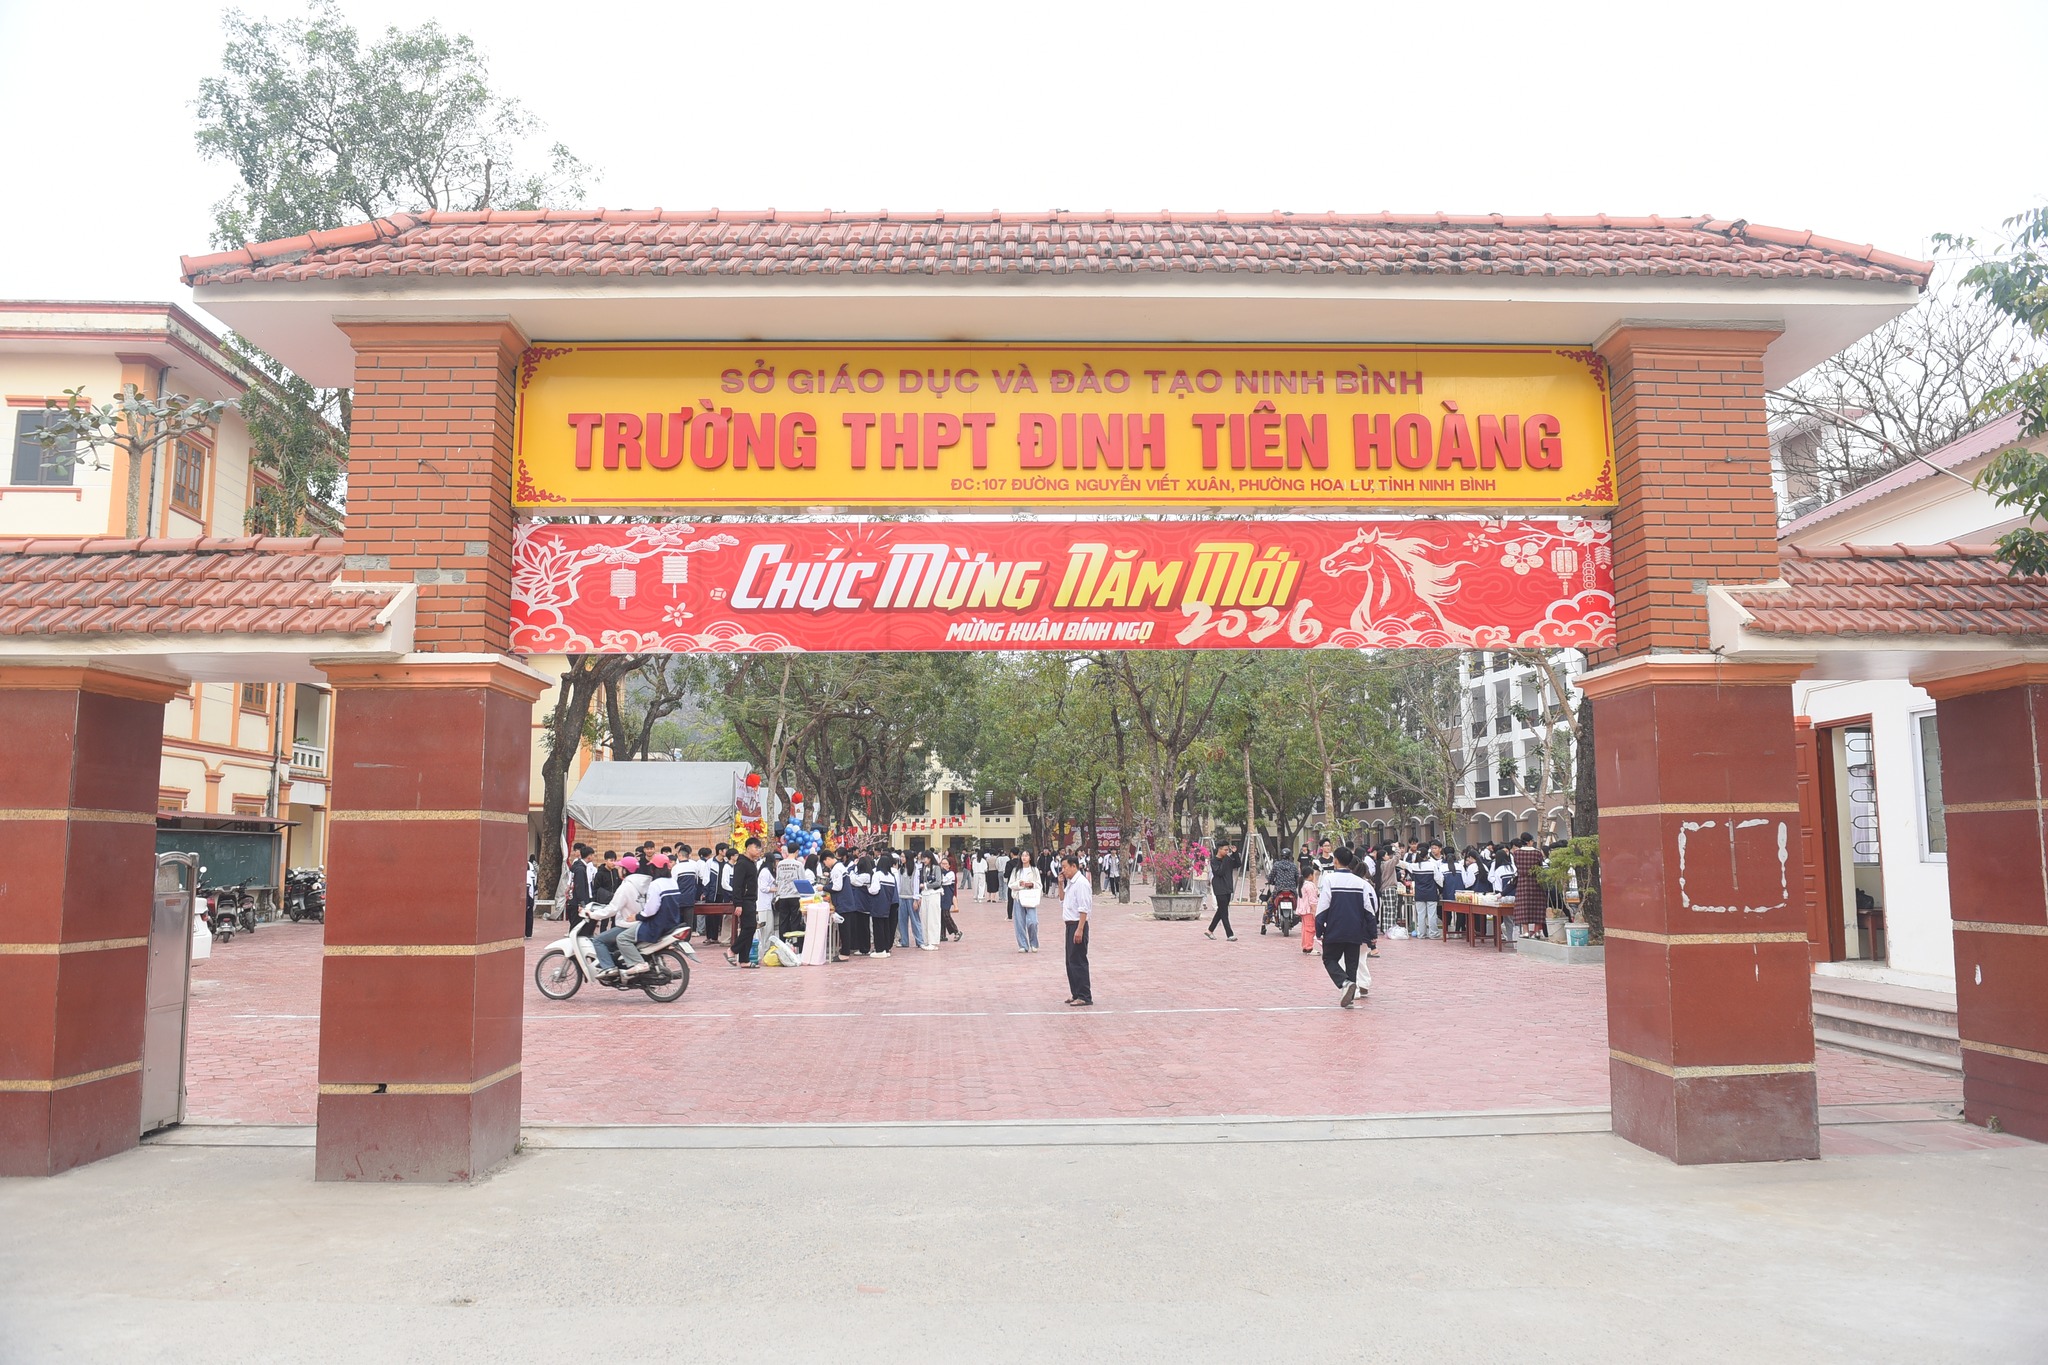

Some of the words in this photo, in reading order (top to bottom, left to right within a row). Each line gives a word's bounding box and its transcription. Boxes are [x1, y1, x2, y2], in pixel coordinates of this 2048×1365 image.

[720, 359, 775, 394] SỞ
[787, 362, 885, 394] GIÁO
[899, 368, 979, 398] DỤC
[991, 362, 1038, 394] VÀ
[1051, 362, 1131, 394] ĐÀO
[1143, 369, 1223, 399] TẠO
[1235, 369, 1324, 395] NINH
[1336, 364, 1424, 395] BÌNH
[568, 398, 818, 471] TRƯỜNG
[842, 412, 996, 471] THPT
[1017, 412, 1167, 471] ĐINH
[1192, 400, 1329, 471] TIÊN
[1352, 400, 1563, 472] HOÀNG
[1011, 475, 1069, 491] ĐƯỜNG
[1076, 474, 1141, 491] NGUYỄN
[1146, 473, 1180, 491] VIẾT
[1186, 476, 1235, 493] XUÂN,
[1239, 476, 1305, 491] PHƯỜNG
[1310, 479, 1344, 491] HOA
[1378, 476, 1415, 491] TỈNH
[1419, 479, 1455, 491] NINH
[1460, 476, 1496, 491] BÌNH
[730, 543, 878, 612] CHÚC
[873, 543, 1043, 611] MỪNG
[1053, 543, 1183, 607] NĂM
[1183, 542, 1300, 607] MỚI
[946, 617, 1006, 643] MỪNG
[1006, 617, 1064, 643] XUÂN
[1064, 617, 1116, 641] BÍNH
[1112, 621, 1155, 644] NGỌ
[1175, 599, 1323, 646] 2026
